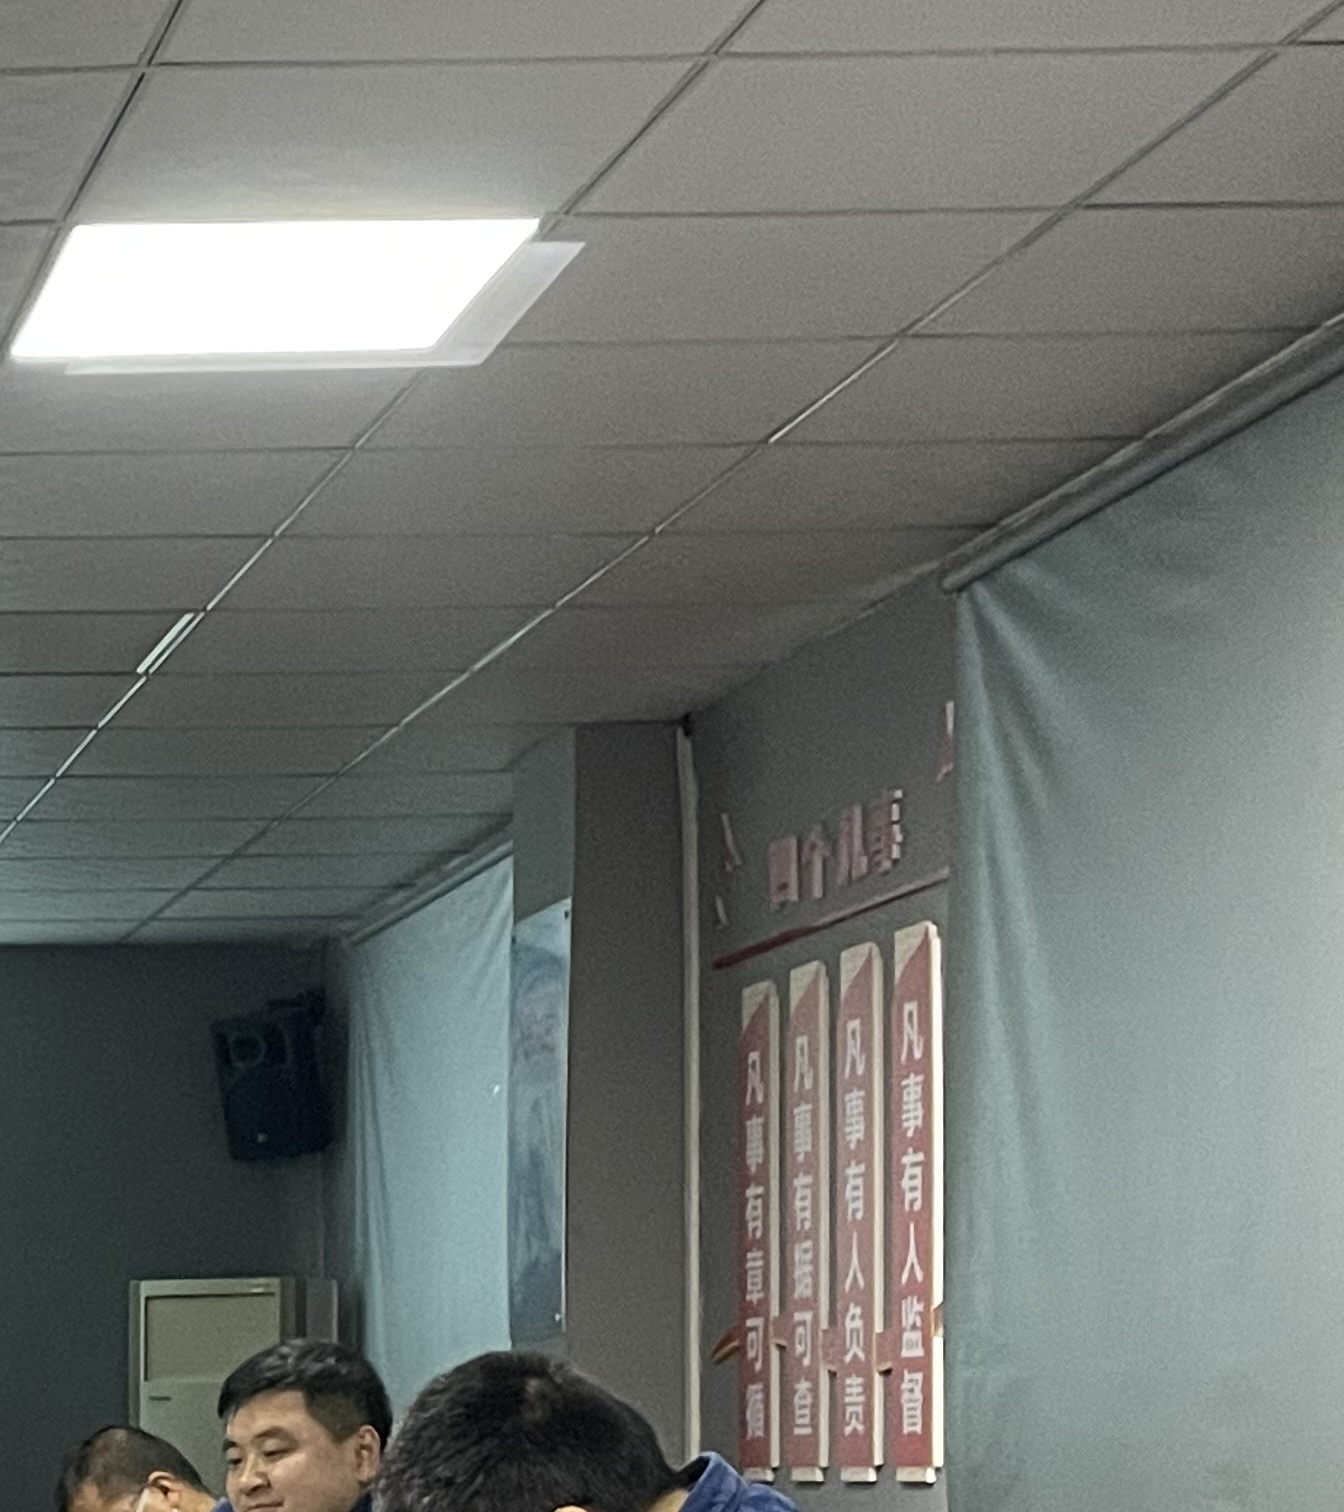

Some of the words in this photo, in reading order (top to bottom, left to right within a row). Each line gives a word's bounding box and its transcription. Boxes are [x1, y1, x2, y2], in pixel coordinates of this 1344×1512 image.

[844, 1018, 866, 1437] 凡事有人负责
[900, 1001, 925, 1436] 凡事有人监督
